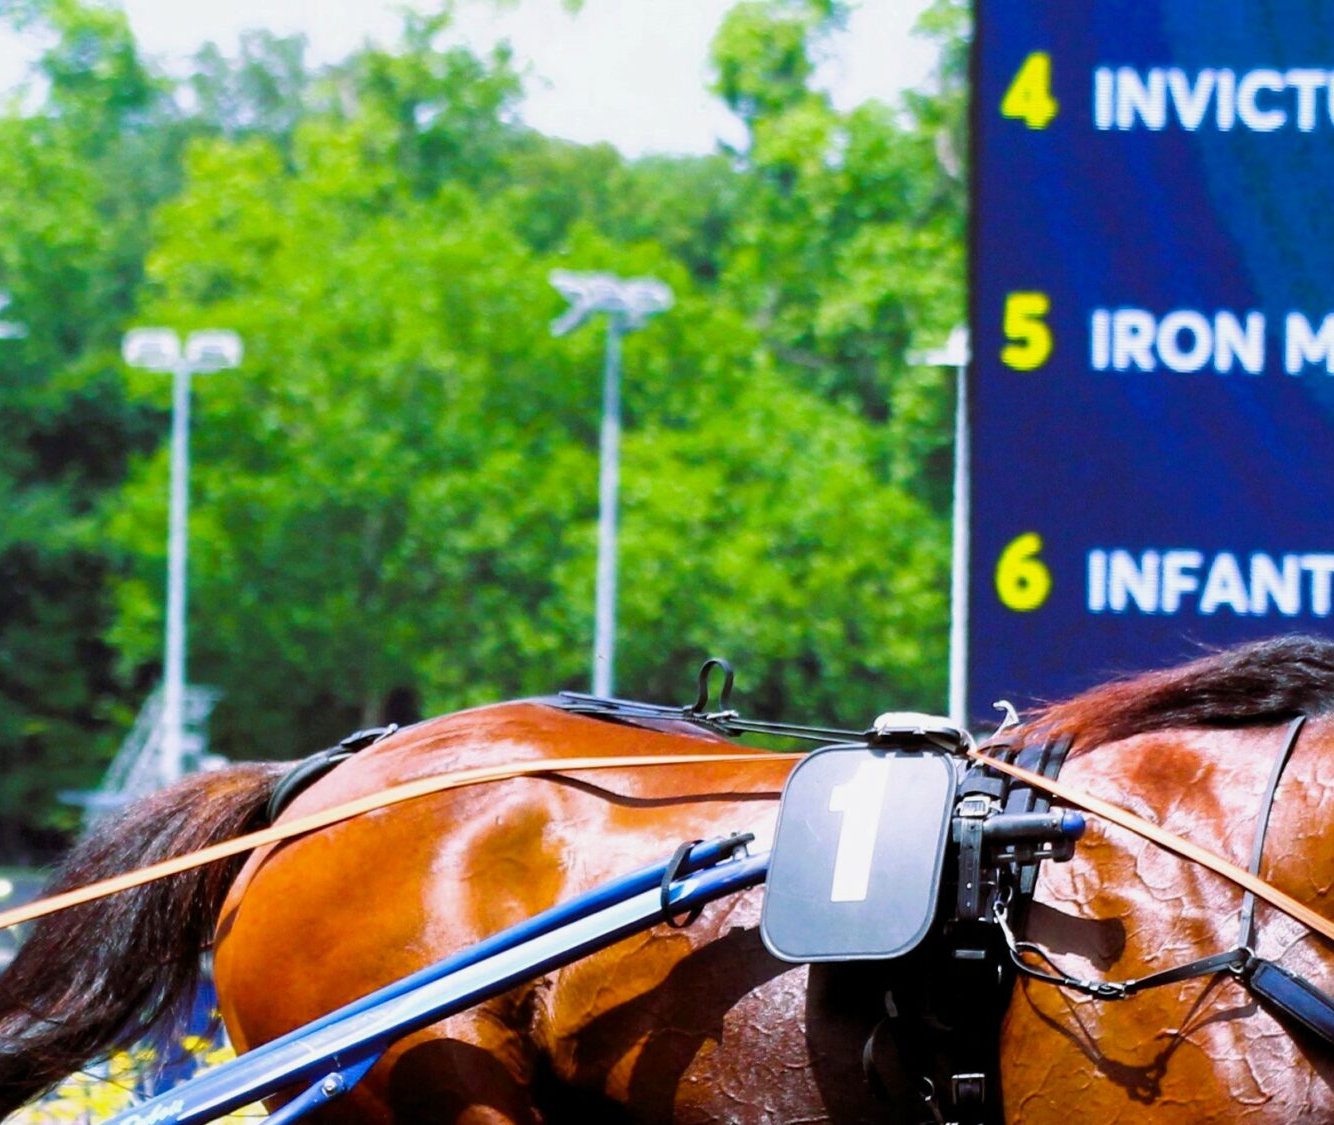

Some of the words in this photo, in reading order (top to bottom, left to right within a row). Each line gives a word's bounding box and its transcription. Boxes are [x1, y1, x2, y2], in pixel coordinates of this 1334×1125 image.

[1002, 52, 1058, 129] 4
[1001, 292, 1053, 371] 5
[1091, 309, 1266, 374] IRON
[995, 533, 1051, 611] 6
[828, 754, 891, 902] 1
